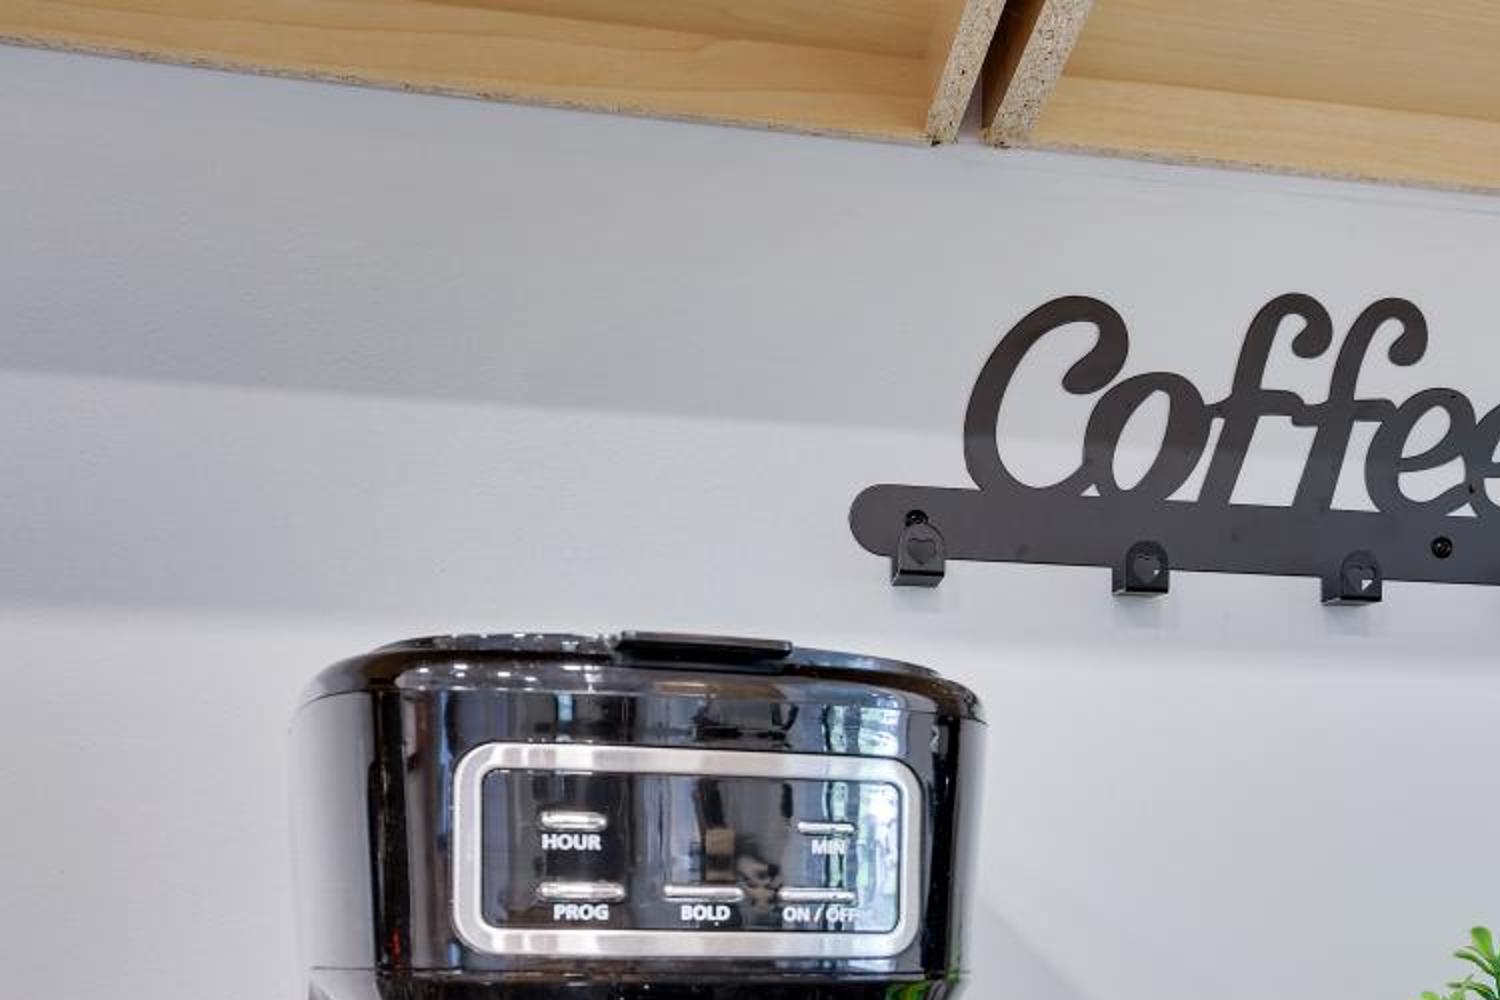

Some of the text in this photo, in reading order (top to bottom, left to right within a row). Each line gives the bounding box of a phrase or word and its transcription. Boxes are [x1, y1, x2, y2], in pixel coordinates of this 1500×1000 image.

[541, 833, 603, 851] HOUR
[810, 839, 848, 855] MIN
[553, 903, 609, 921] PROG
[680, 905, 731, 922] BOLD
[782, 907, 810, 922] ON
